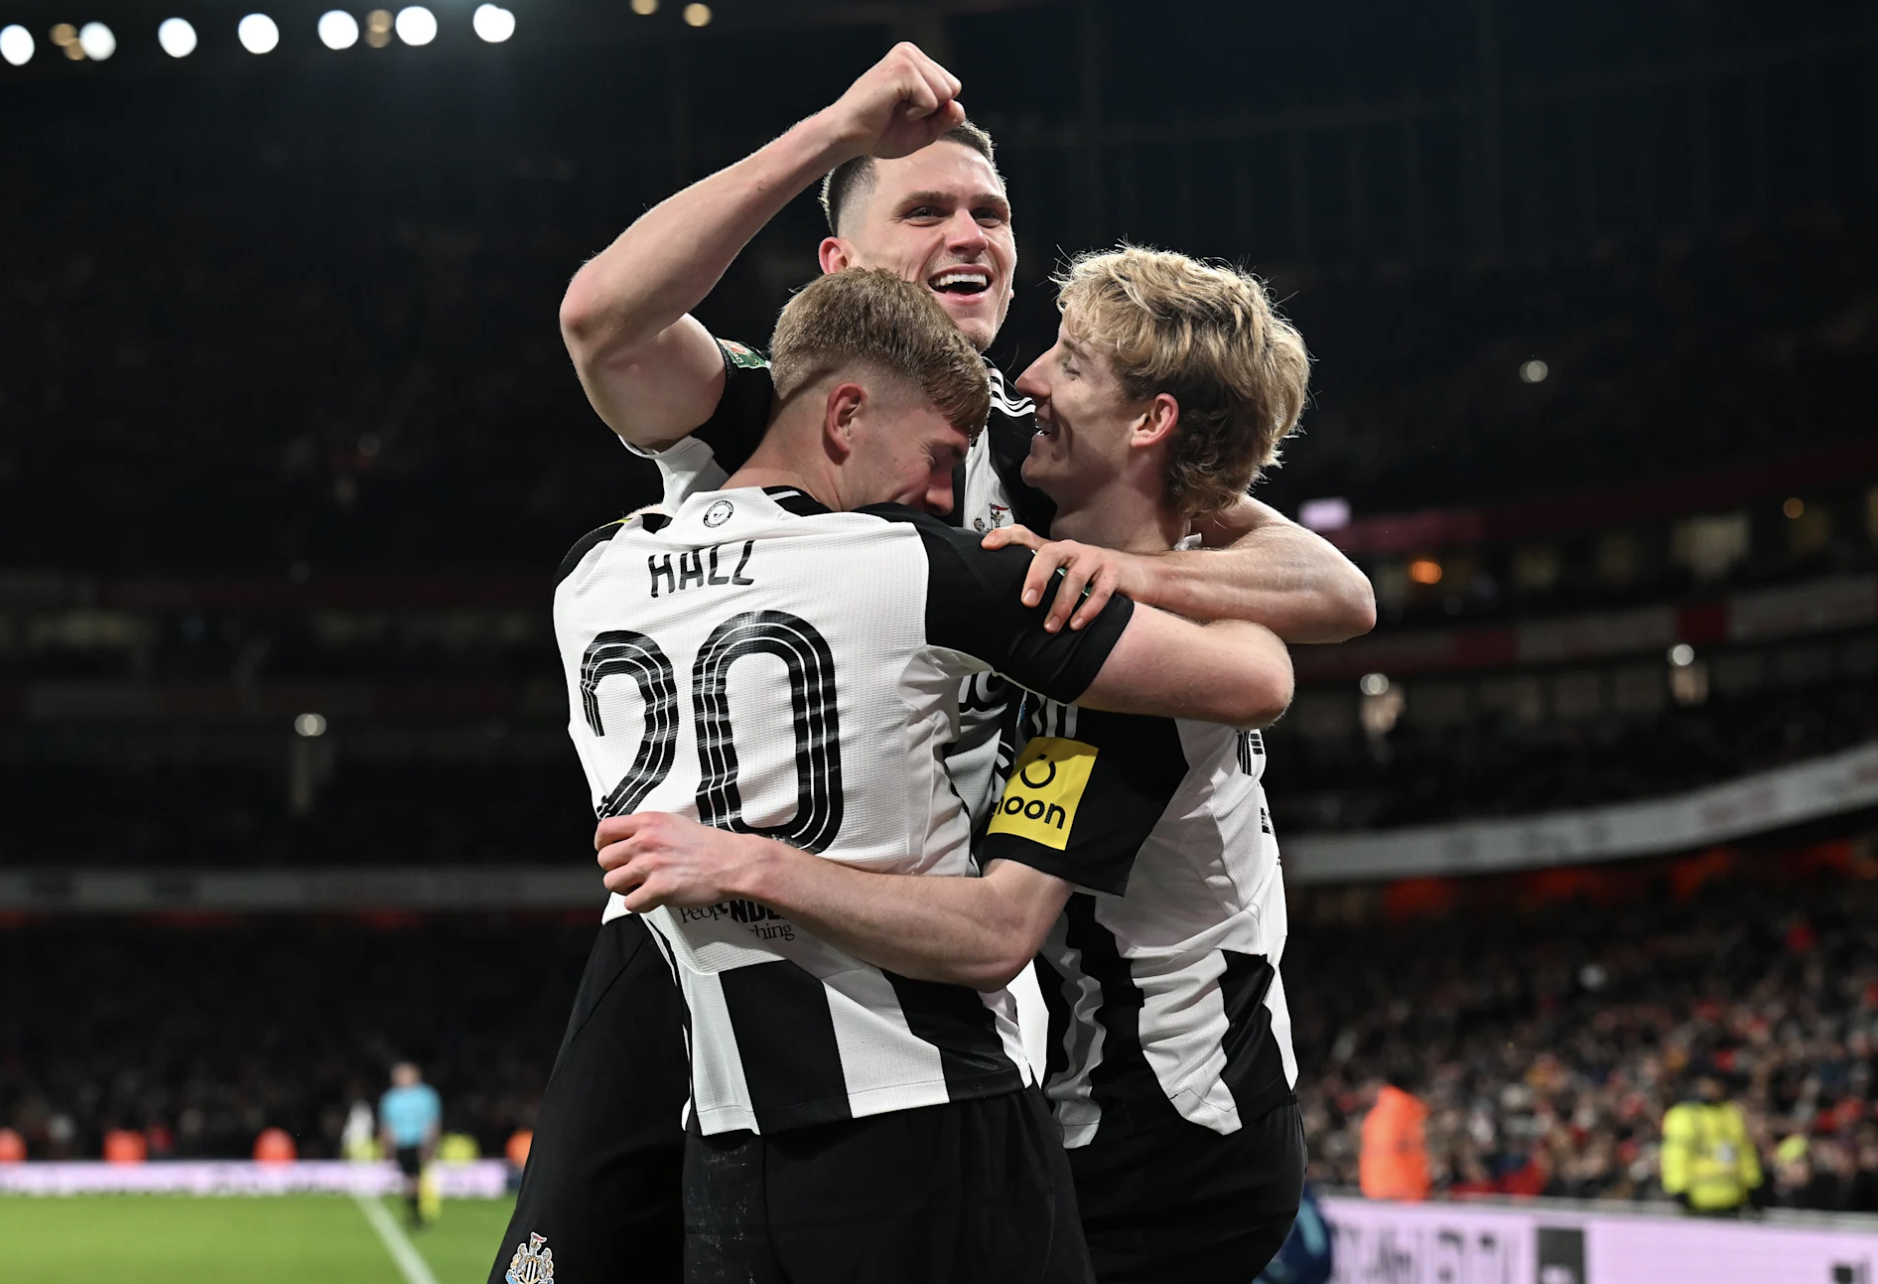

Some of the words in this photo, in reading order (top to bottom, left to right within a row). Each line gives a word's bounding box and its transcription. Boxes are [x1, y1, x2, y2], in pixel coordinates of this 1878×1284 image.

[647, 539, 756, 598] HALL
[580, 609, 844, 856] 20
[679, 905, 724, 924] Peop
[749, 922, 795, 942] hing
